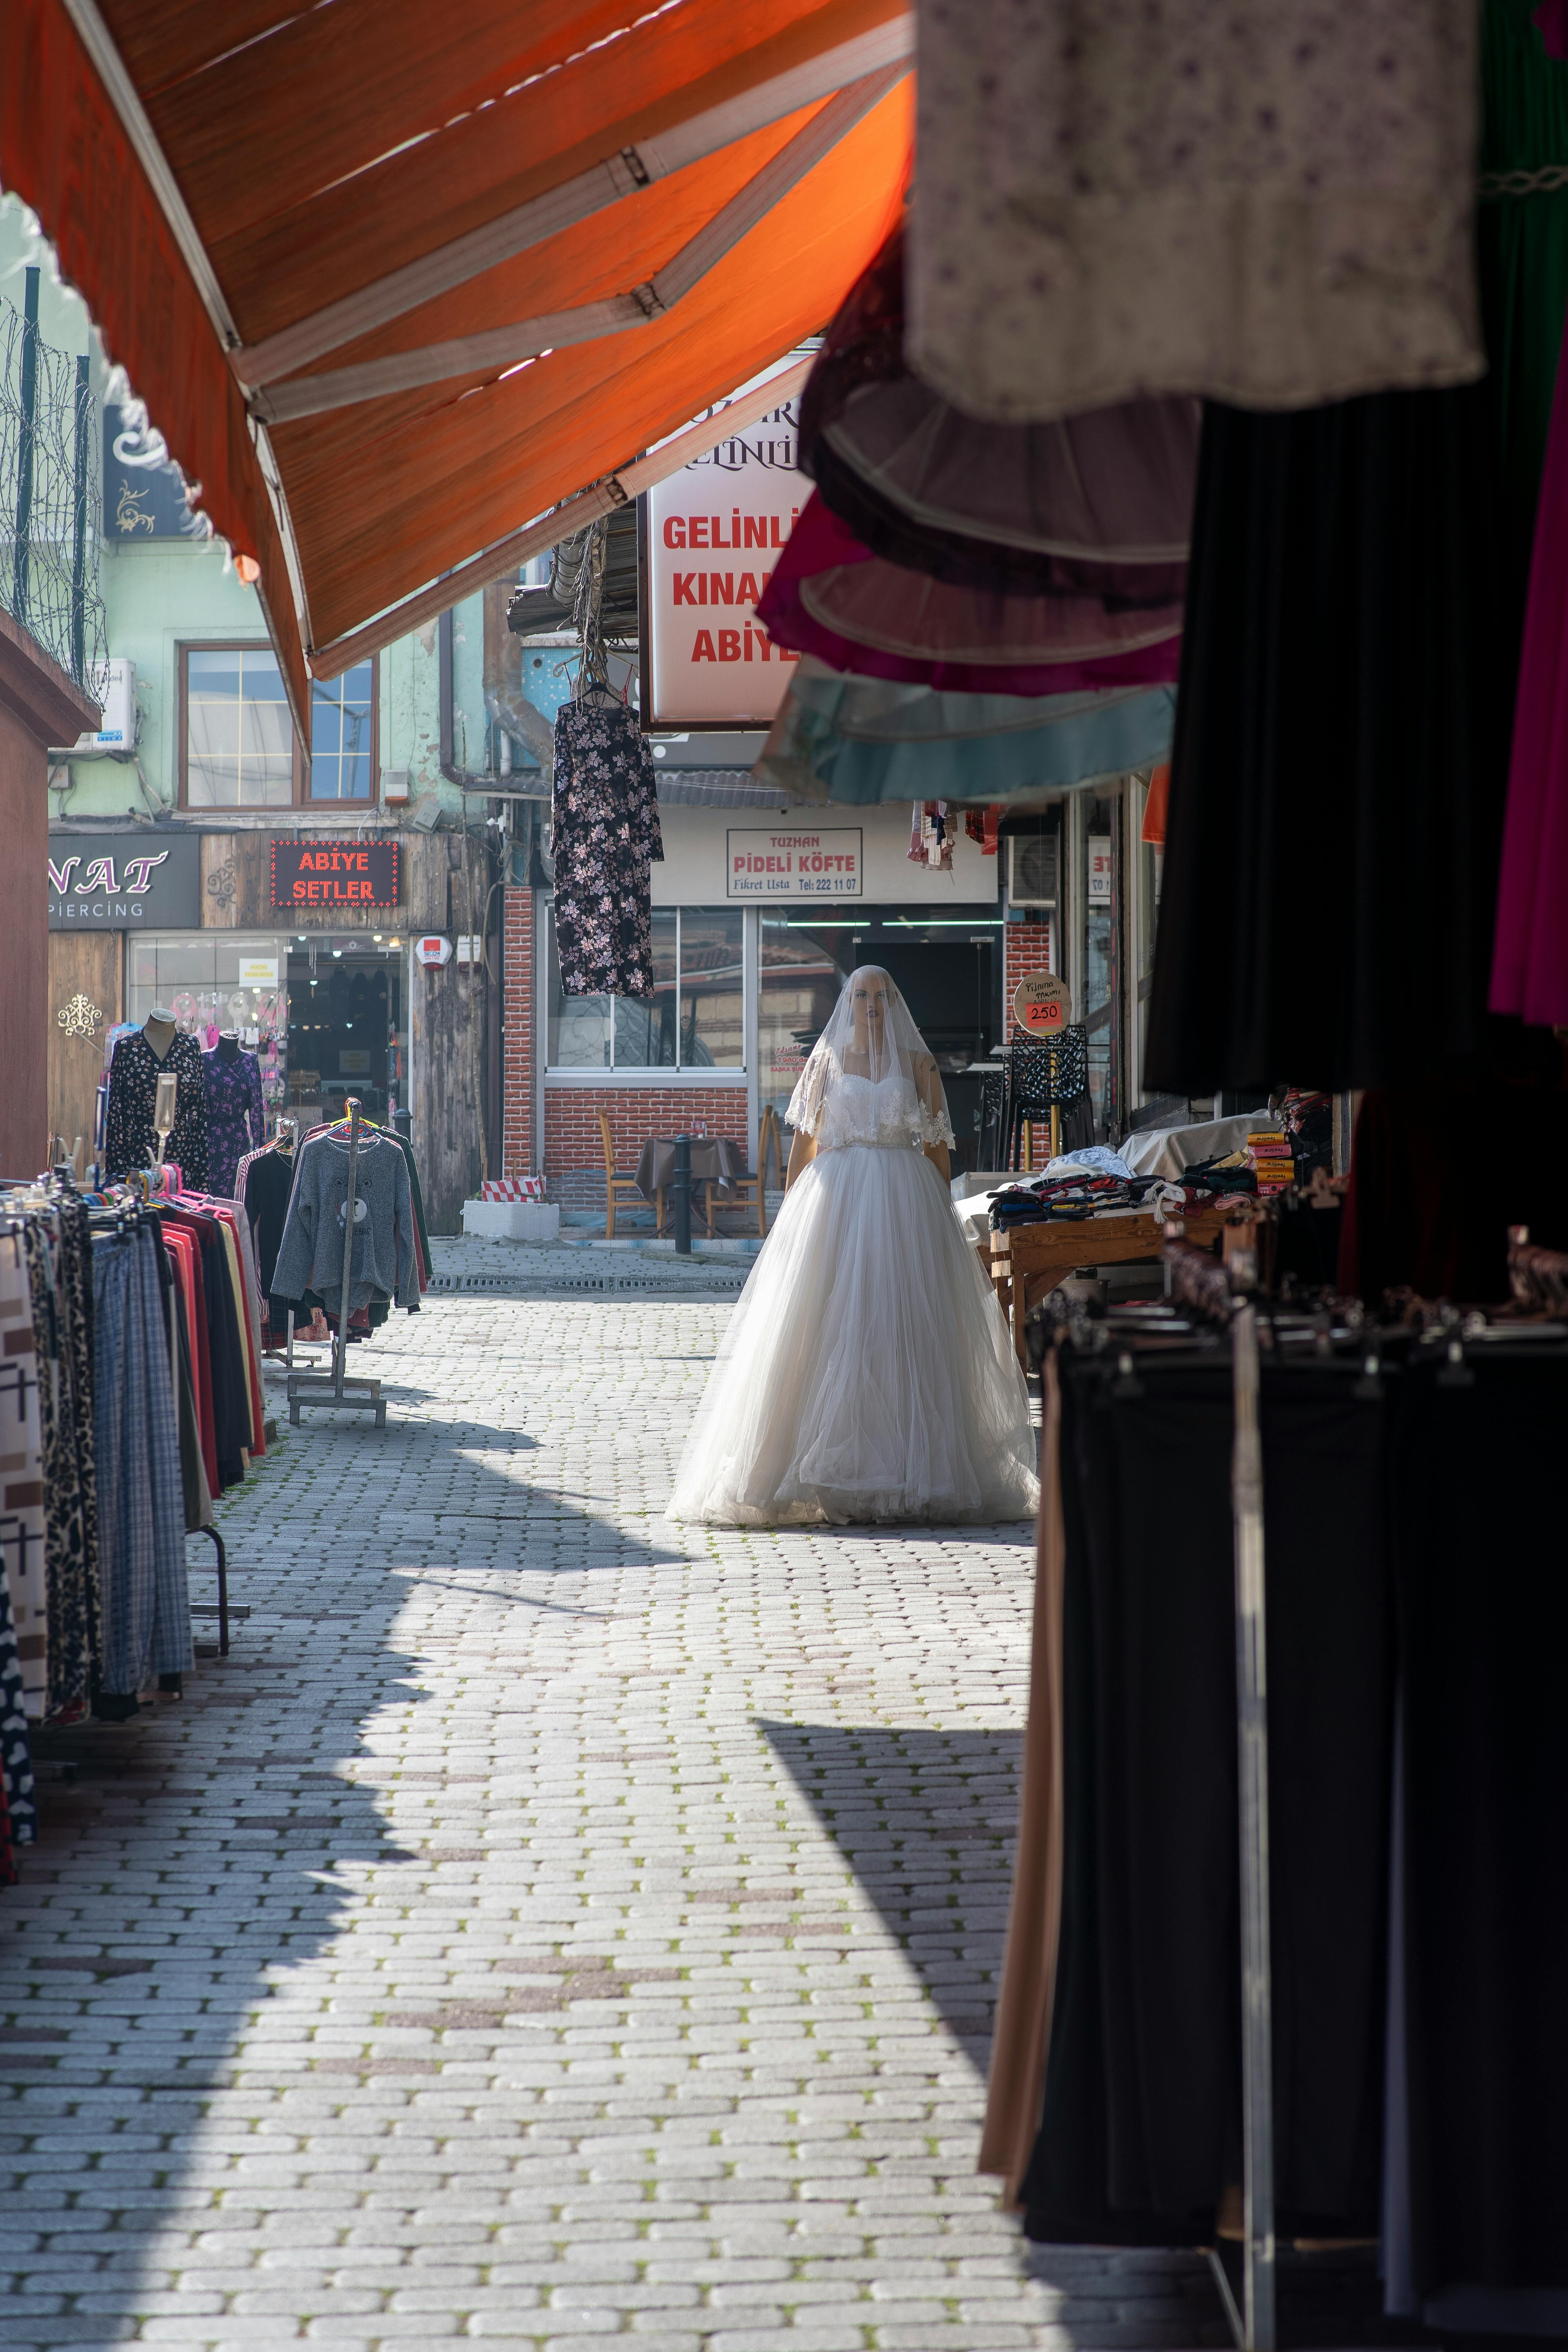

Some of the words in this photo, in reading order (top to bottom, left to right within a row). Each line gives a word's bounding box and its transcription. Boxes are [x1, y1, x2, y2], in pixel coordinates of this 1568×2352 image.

[673, 572, 771, 605] KINA
[770, 837, 820, 848] TUZHAN
[299, 847, 368, 870] ABİYE
[734, 852, 791, 873] PİDELİ
[799, 851, 855, 872] KÖFTE
[293, 881, 375, 899] SETLER
[733, 878, 763, 890] Fikret
[767, 879, 790, 889] Usta
[799, 879, 814, 890] Tel:
[816, 879, 831, 890] 222
[834, 879, 843, 890] 11
[846, 878, 856, 889] 07
[1031, 1005, 1058, 1020] 250
